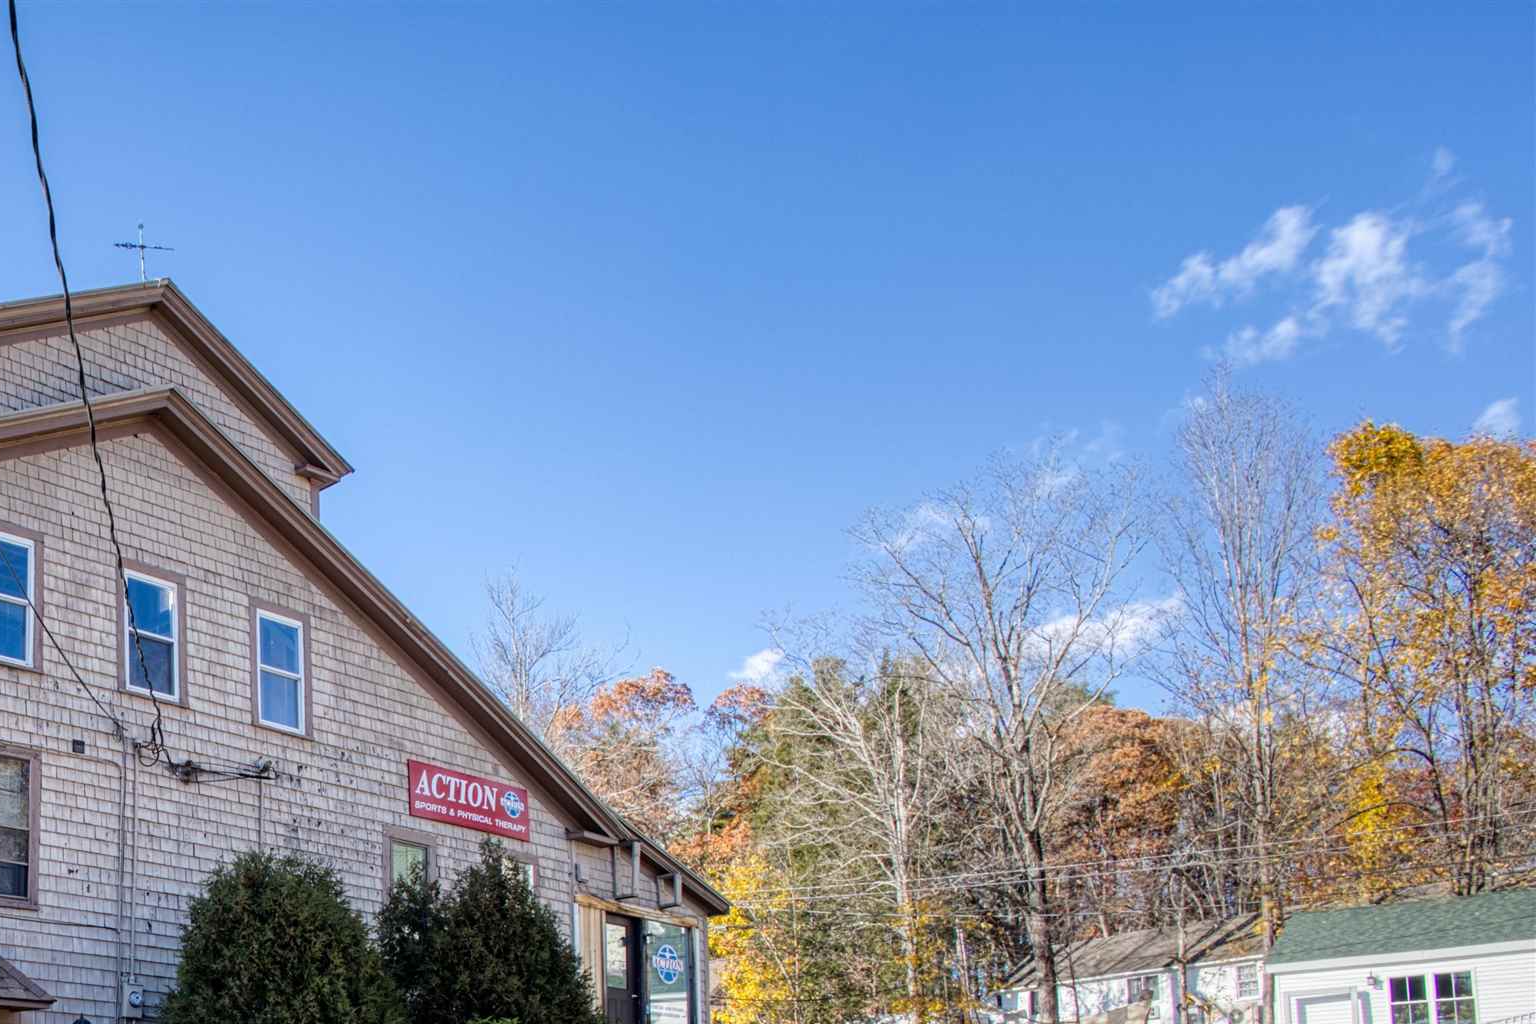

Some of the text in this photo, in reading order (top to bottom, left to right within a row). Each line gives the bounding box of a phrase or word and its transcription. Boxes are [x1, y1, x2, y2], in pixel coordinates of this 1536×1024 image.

[415, 769, 498, 812] ACTION
[415, 800, 527, 833] SPORTS & PHYSICAL THERAPY
